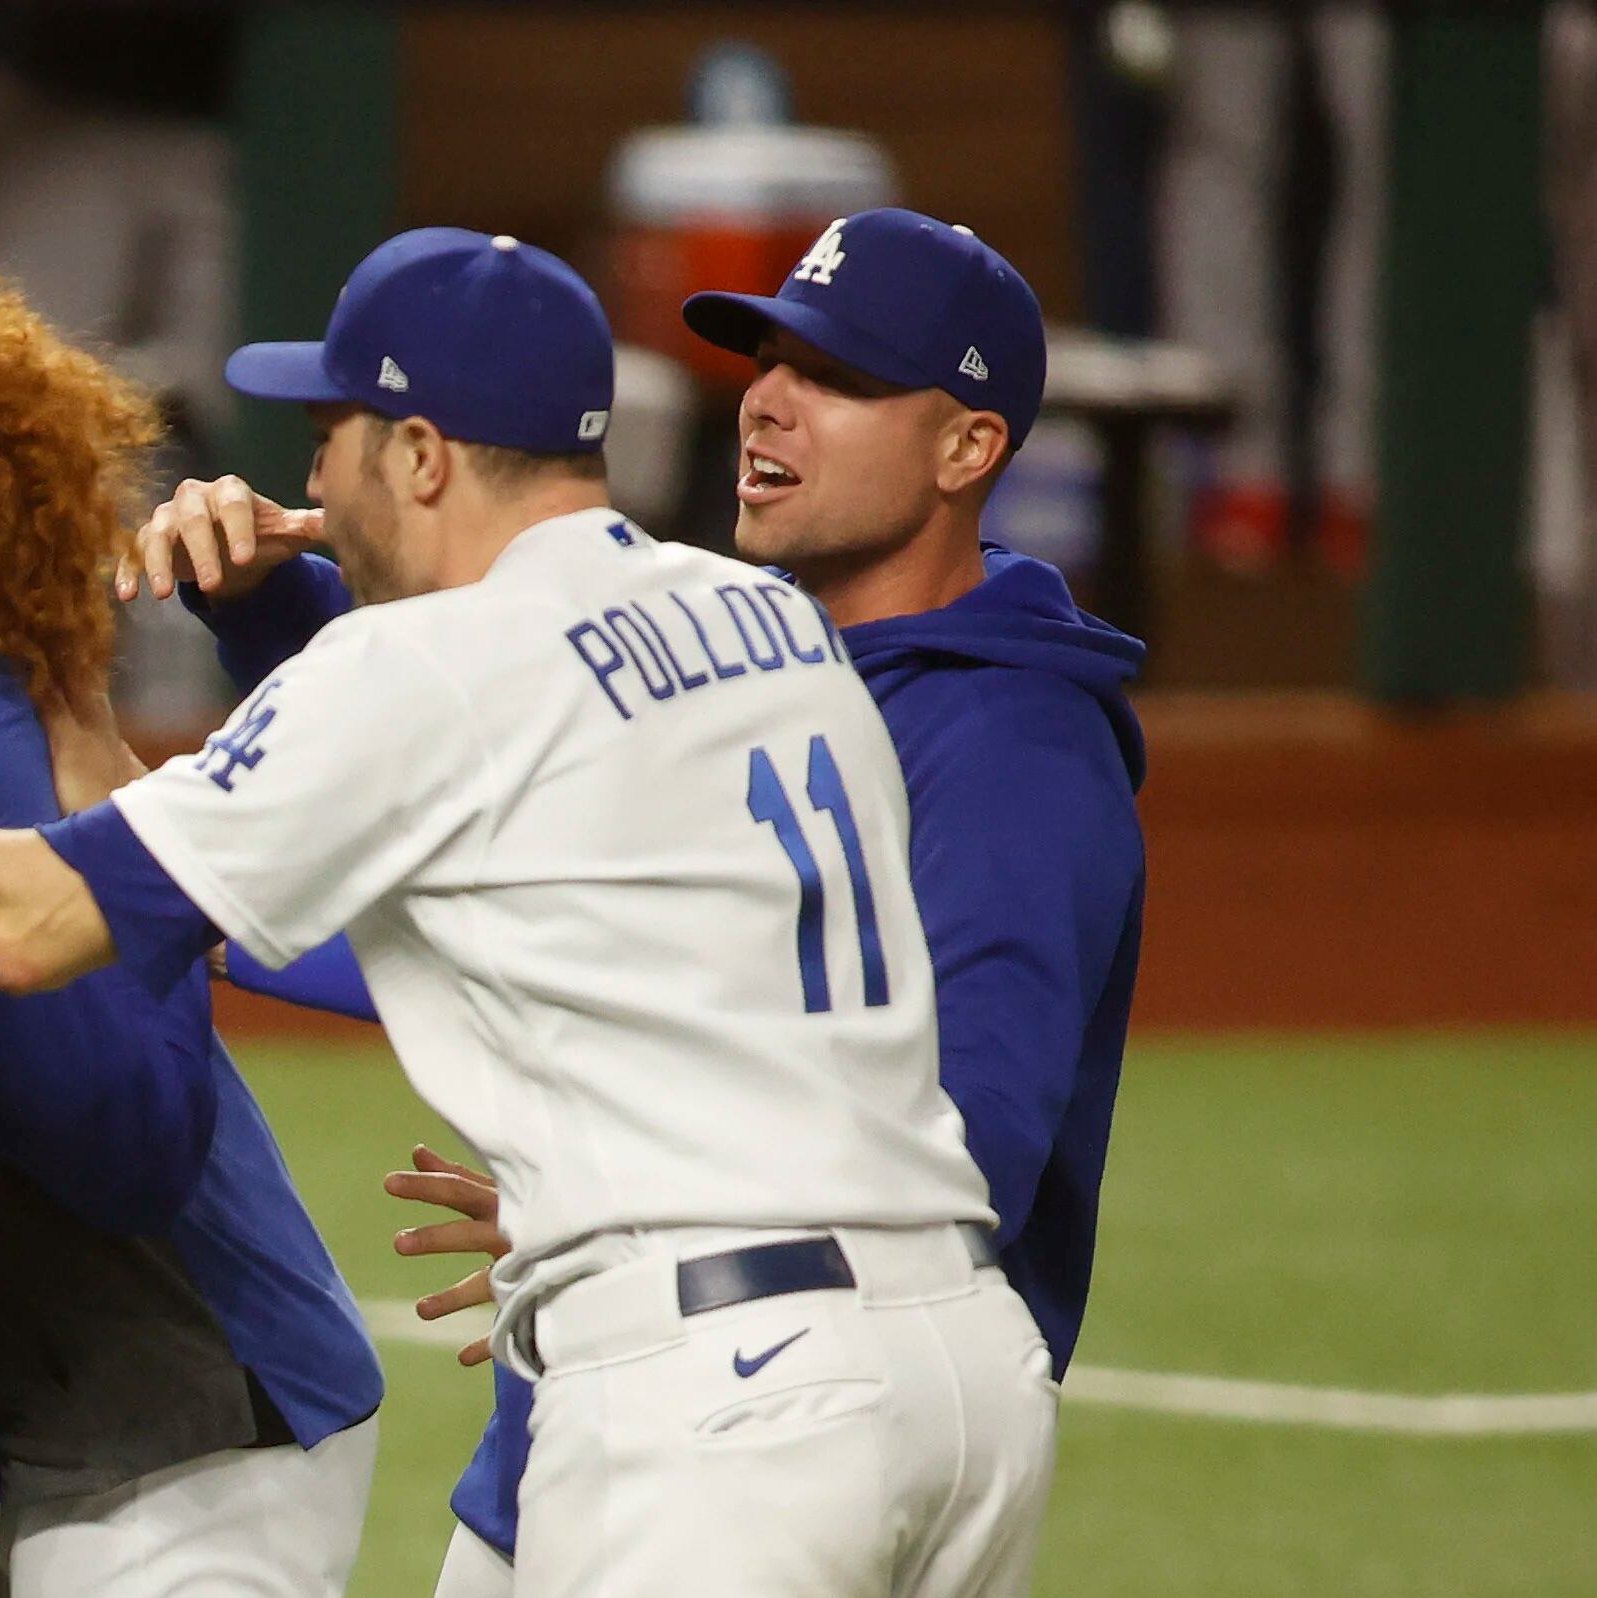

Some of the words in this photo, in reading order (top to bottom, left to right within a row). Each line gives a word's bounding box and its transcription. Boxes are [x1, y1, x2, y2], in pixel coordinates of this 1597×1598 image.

[794, 218, 847, 286] LA
[194, 681, 282, 792] LA
[746, 733, 890, 1013] 11
